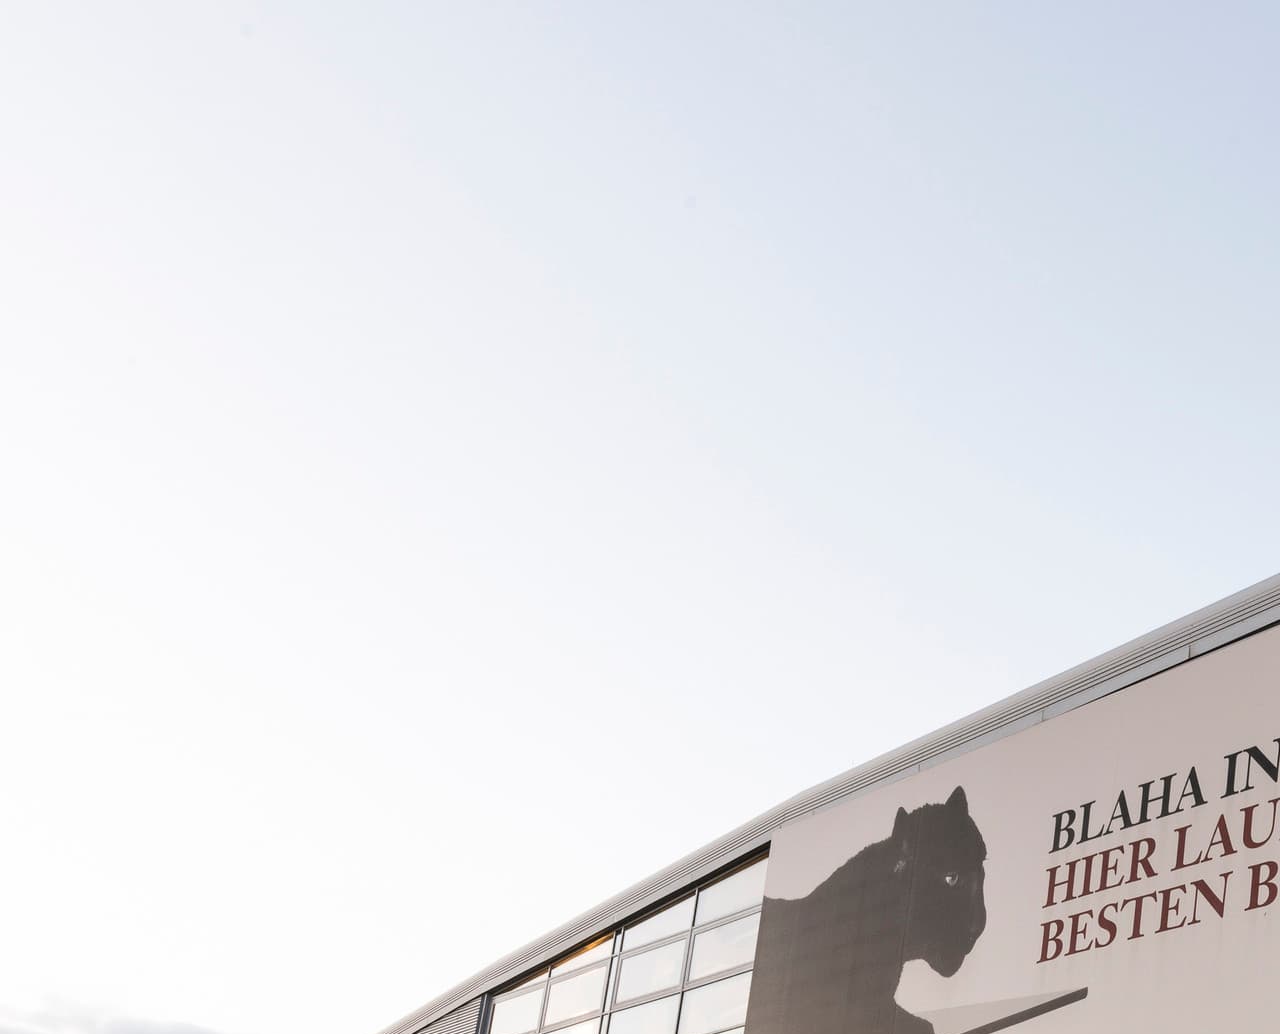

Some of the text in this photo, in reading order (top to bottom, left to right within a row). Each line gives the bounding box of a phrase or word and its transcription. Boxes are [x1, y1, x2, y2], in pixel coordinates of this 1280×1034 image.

[1049, 765, 1209, 855] BLAHA
[1036, 871, 1234, 964] BESTEN
[1042, 837, 1159, 909] HIER
